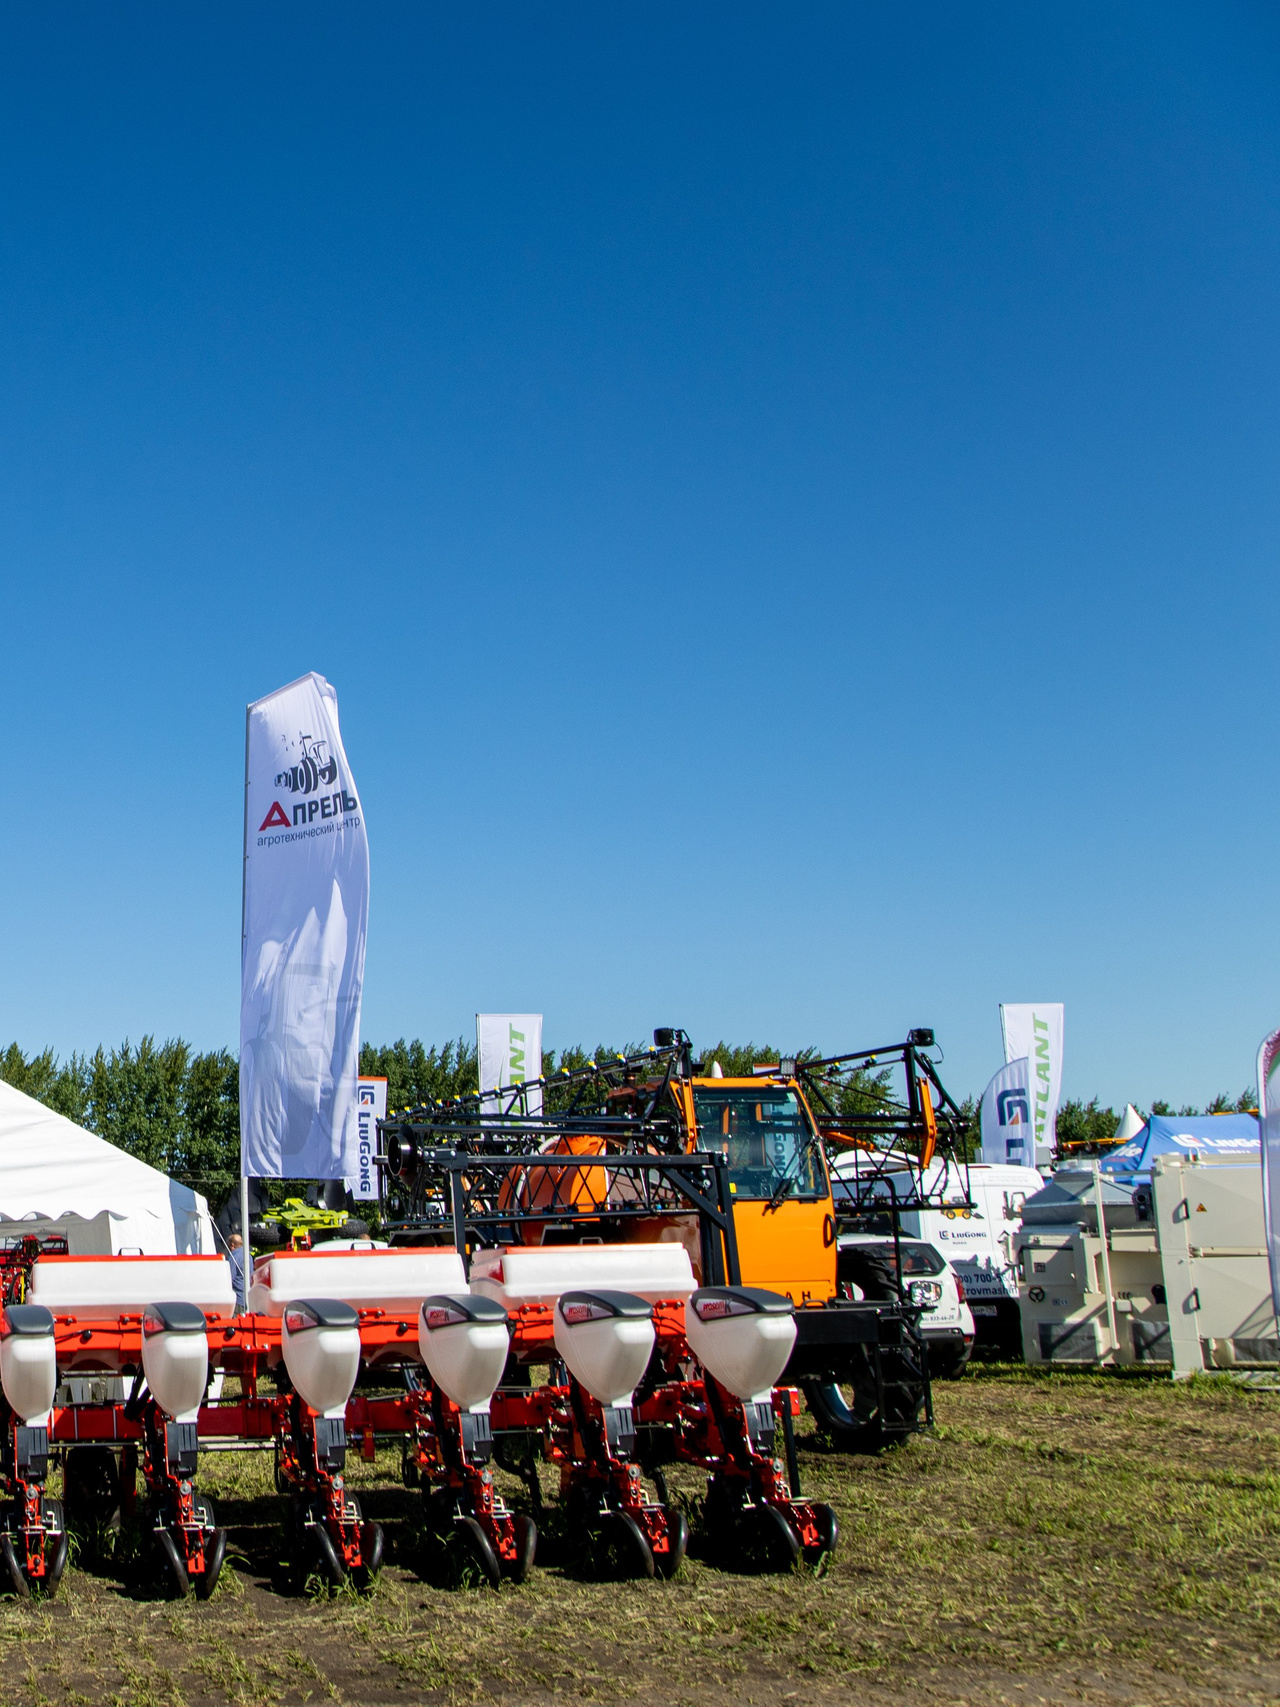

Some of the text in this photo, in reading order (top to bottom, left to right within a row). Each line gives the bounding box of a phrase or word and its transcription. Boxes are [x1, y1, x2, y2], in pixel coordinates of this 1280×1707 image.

[258, 790, 358, 832] АПРЕЛЬ
[257, 821, 334, 848] агротехнический
[1032, 1012, 1051, 1143] ATLANT
